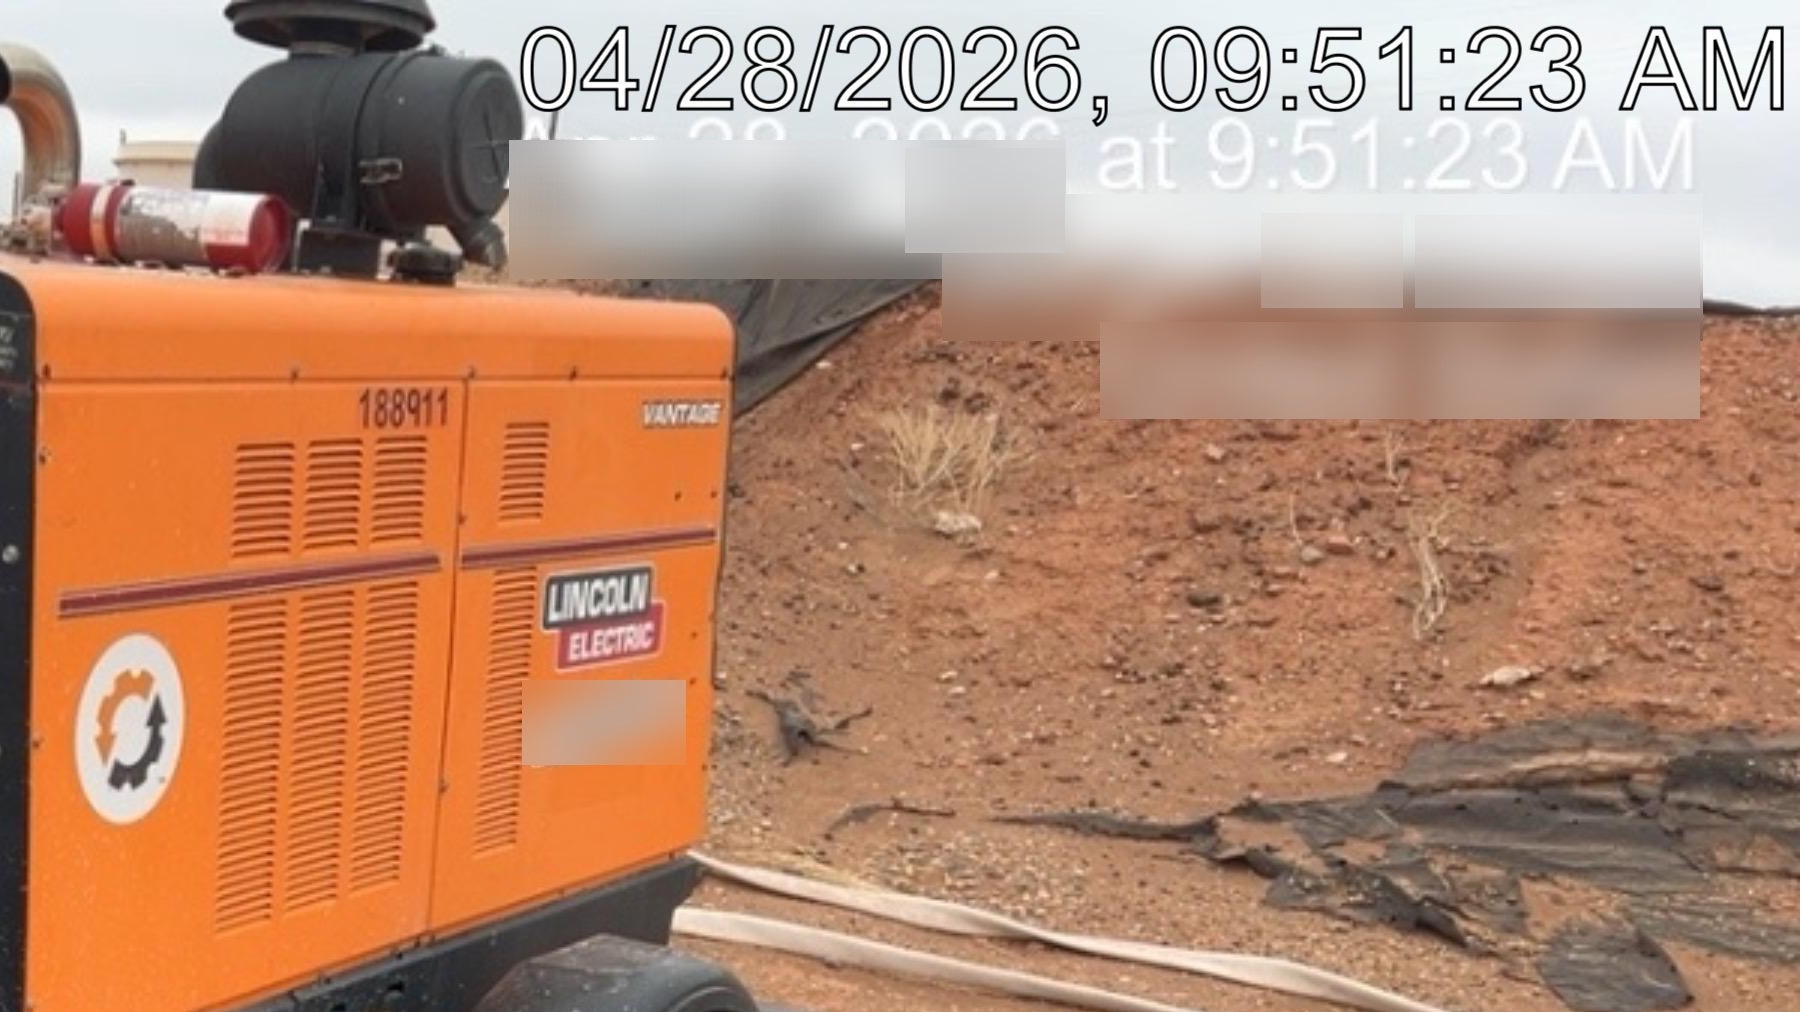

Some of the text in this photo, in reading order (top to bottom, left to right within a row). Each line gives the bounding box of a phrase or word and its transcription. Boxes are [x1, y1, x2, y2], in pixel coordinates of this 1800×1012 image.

[359, 388, 448, 429] 188911
[643, 401, 721, 426] VANTAGE
[548, 573, 650, 623] LINCOLN
[569, 621, 654, 662] ELECTRIC
